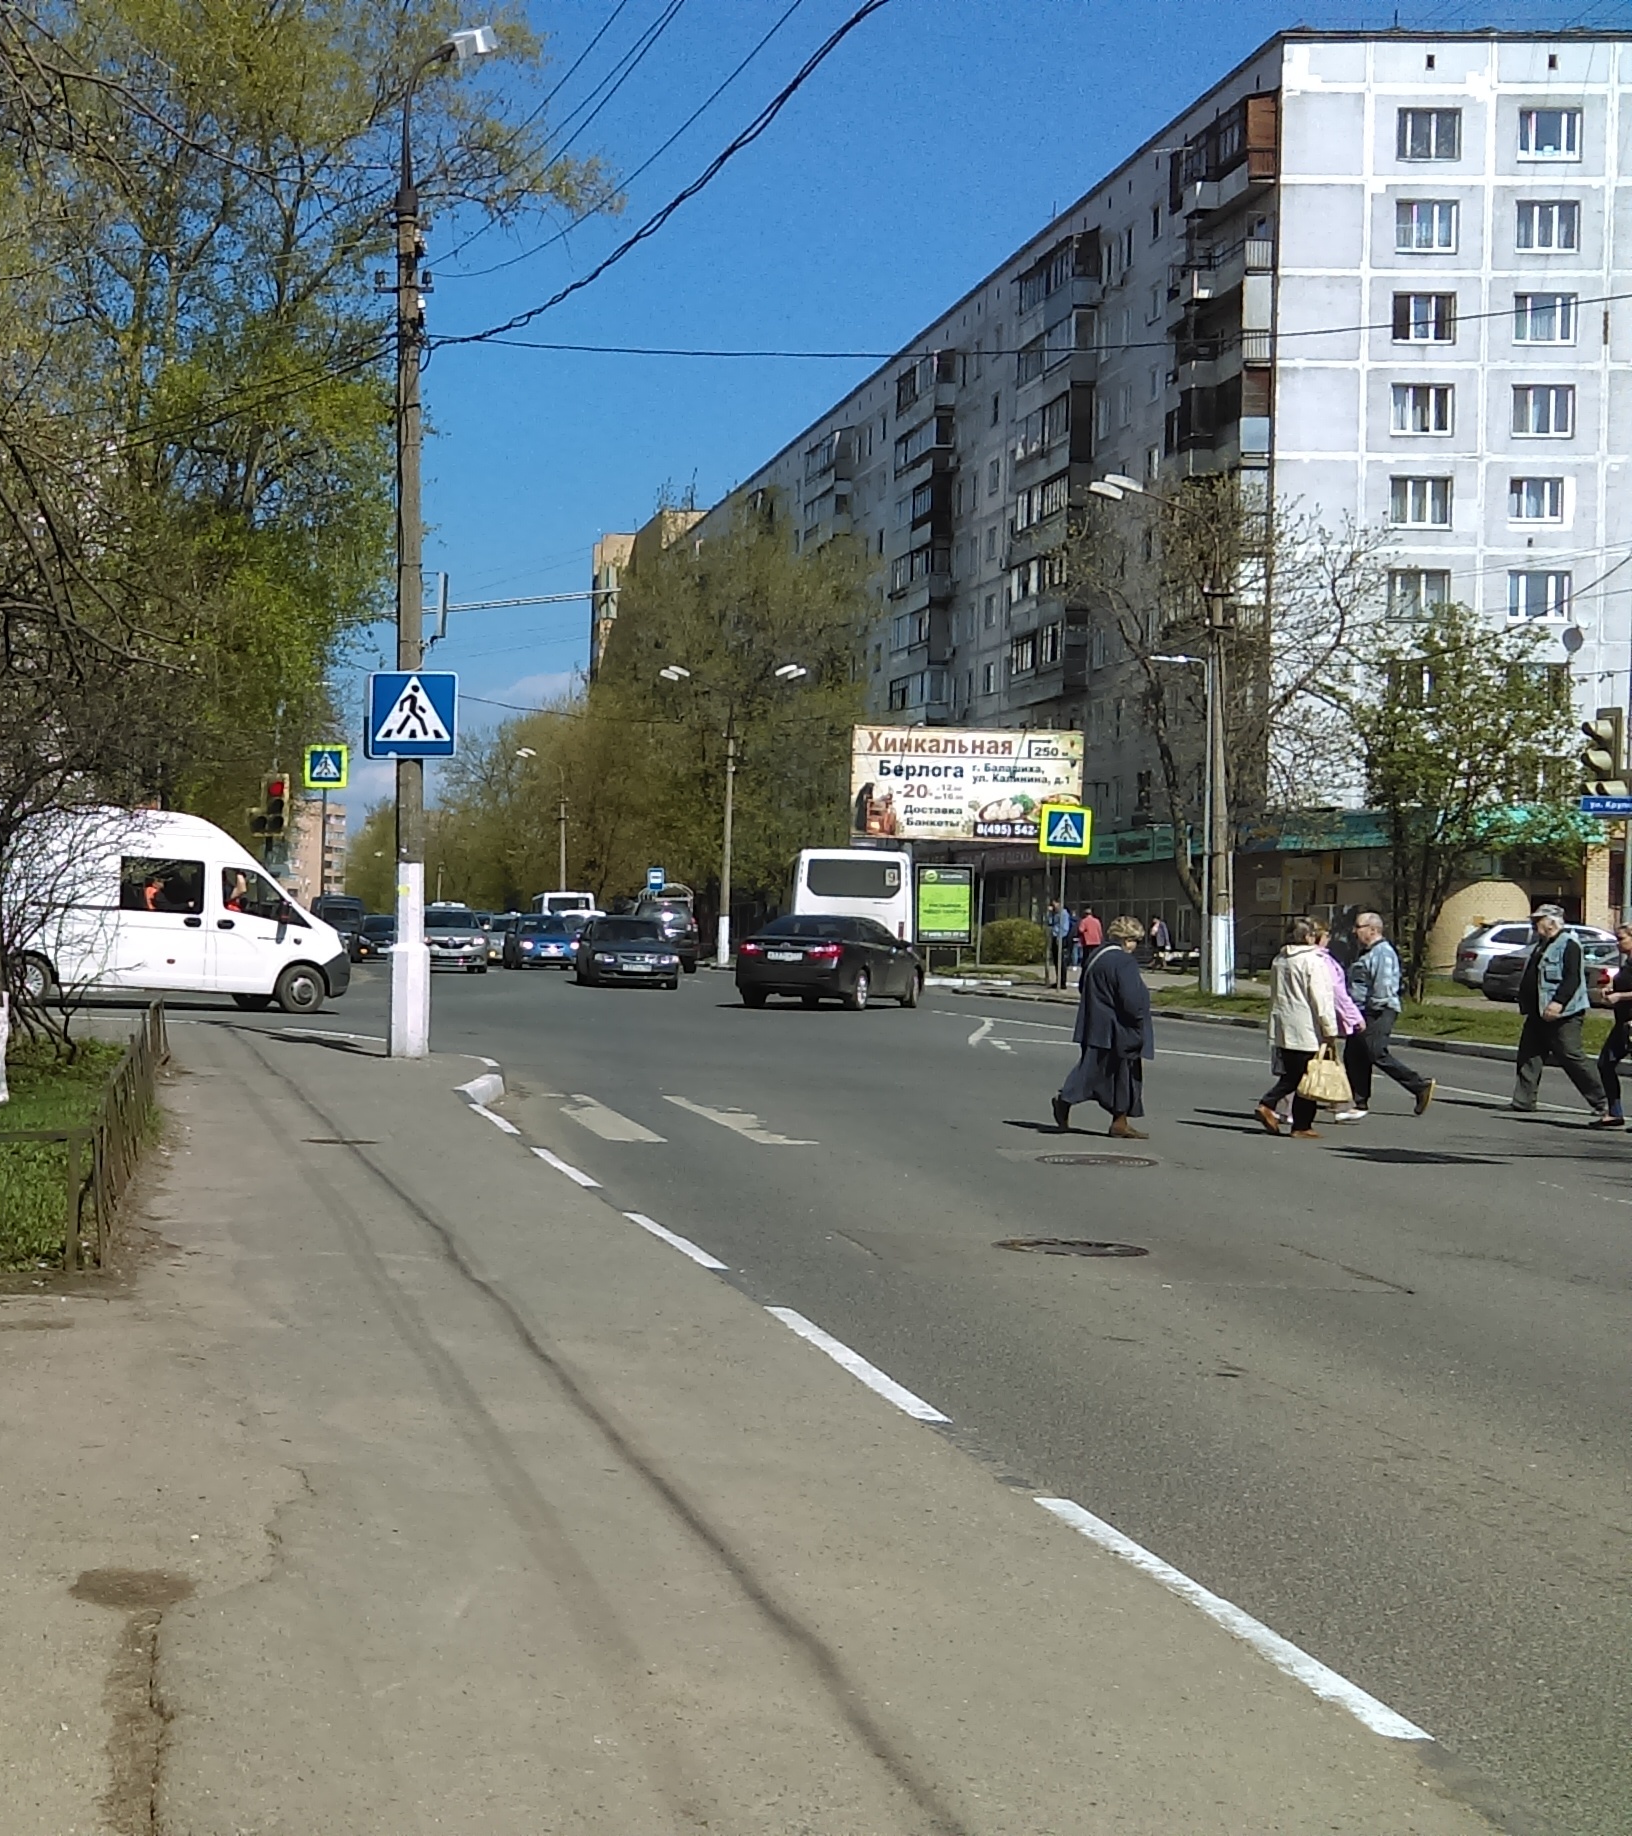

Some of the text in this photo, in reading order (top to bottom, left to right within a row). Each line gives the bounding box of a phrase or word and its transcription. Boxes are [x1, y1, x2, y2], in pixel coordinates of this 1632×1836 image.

[868, 732, 1013, 755] Хинкальная
[1034, 746, 1059, 756] 250
[879, 760, 964, 780] Берлога
[972, 775, 988, 785] ул.
[903, 804, 963, 815] Доставка
[906, 817, 960, 827] Банкеты
[977, 823, 1011, 836] 8(495)
[888, 871, 896, 883] 9
